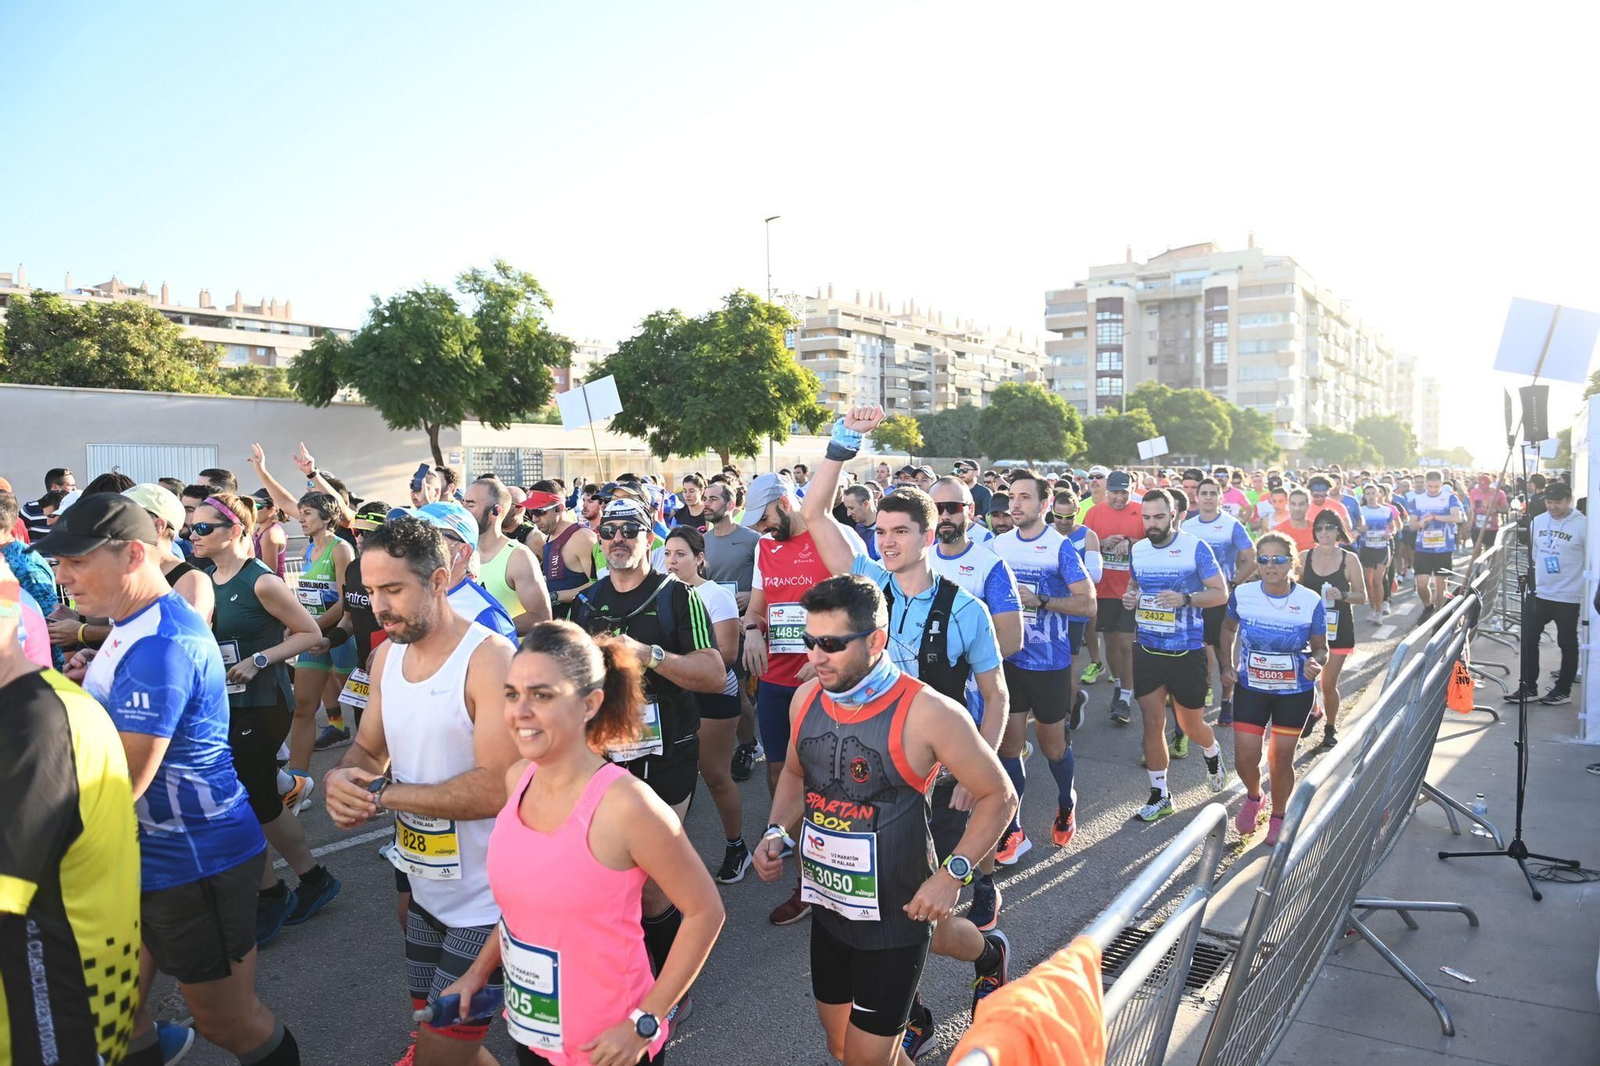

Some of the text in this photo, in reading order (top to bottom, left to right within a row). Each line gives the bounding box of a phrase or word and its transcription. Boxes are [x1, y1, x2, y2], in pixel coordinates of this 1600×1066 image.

[764, 575, 813, 587] TARANCÓN
[1145, 611, 1165, 620] 2432
[776, 627, 800, 638] 4485
[1260, 671, 1283, 679] 5603
[353, 683, 370, 696] 210
[806, 792, 874, 820] SPARTAN
[813, 811, 852, 832] BOX
[403, 830, 427, 852] 828
[837, 853, 860, 862] MARATÓN
[837, 859, 856, 868] MÁLAGA
[815, 867, 853, 893] 3050
[855, 889, 875, 897] málaga
